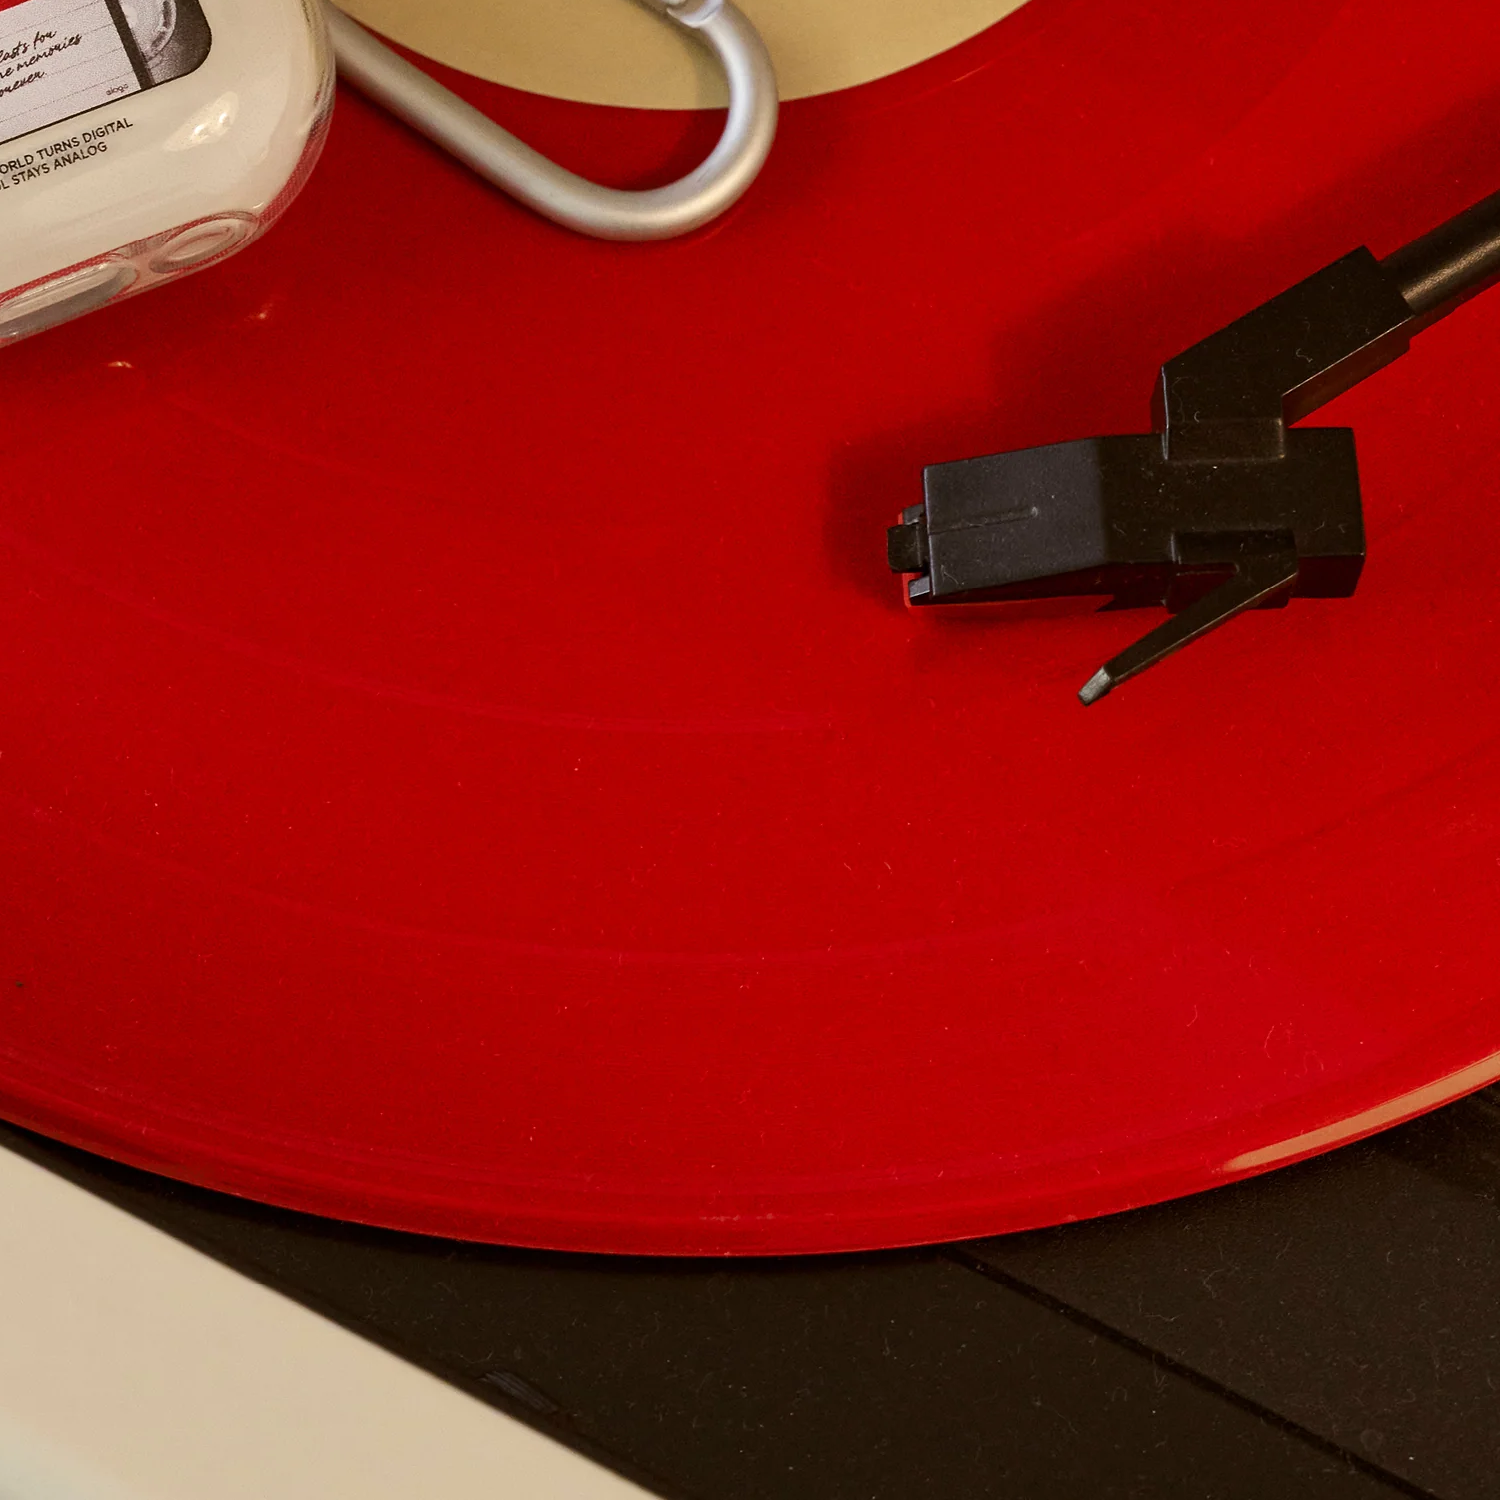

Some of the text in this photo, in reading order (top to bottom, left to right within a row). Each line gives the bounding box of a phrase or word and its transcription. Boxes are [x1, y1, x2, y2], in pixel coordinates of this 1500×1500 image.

[17, 33, 82, 71] memories
[33, 30, 57, 50] for
[36, 136, 81, 160] TURNS
[81, 117, 134, 143] DIGITAL
[11, 163, 51, 186] STAYS
[53, 141, 108, 171] ANALOG
